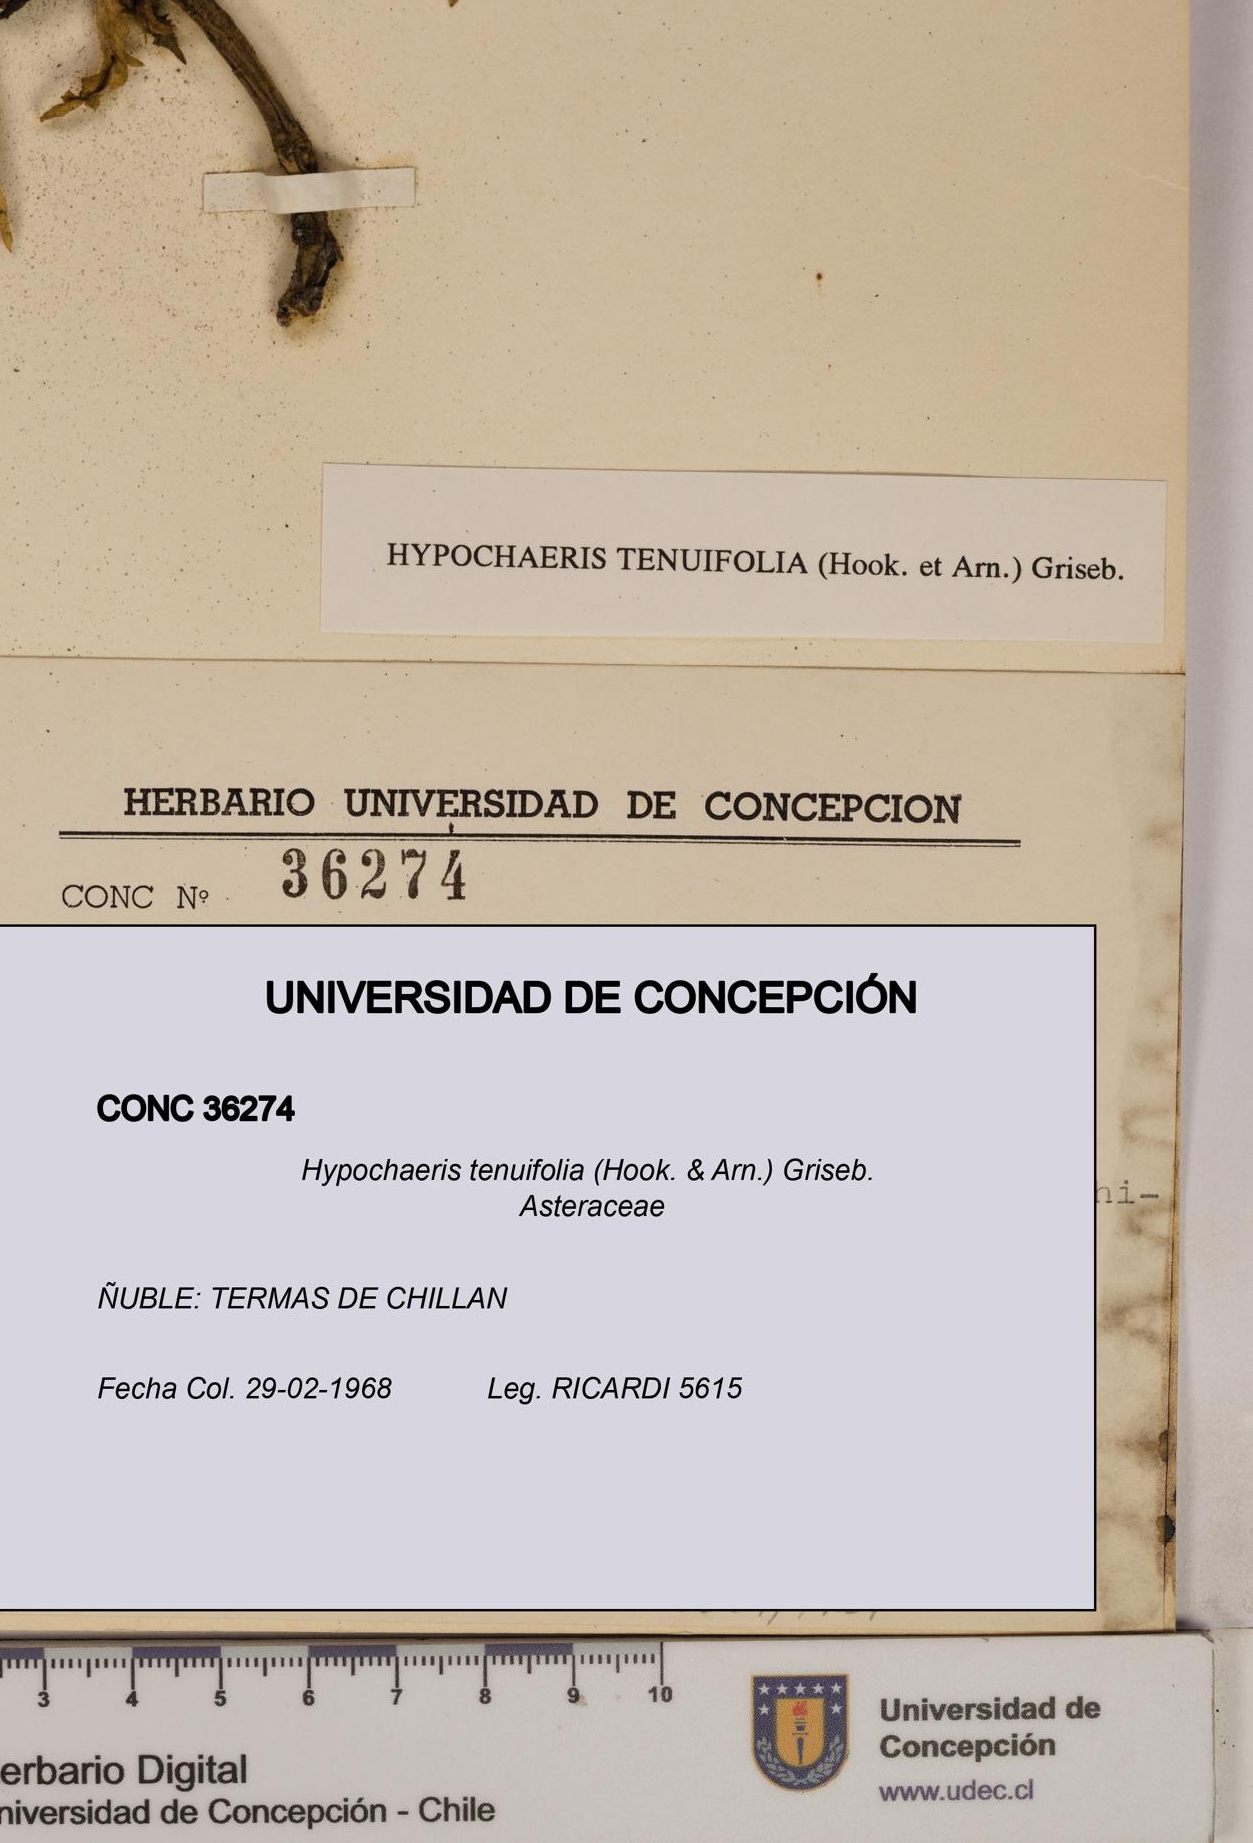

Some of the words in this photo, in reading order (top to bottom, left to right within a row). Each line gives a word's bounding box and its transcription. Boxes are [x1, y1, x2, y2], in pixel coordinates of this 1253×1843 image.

[386, 542, 608, 570] HYPOCHAERIS
[616, 547, 809, 575] TENUIFOLIA
[818, 551, 908, 581] (Hook.
[919, 556, 943, 577] et
[951, 555, 1022, 585] Arn.)
[1031, 555, 1124, 581] Griseb.
[123, 786, 316, 817] HERBARIO
[344, 787, 599, 819] UNIVERSIDAD
[626, 789, 677, 820] DE
[704, 790, 963, 825] CONCEPCION
[61, 884, 155, 910] CONC
[281, 847, 467, 901] 36274
[37, 1693, 51, 1709] 3
[124, 1693, 140, 1708] 4
[213, 1692, 228, 1708] 5
[302, 1692, 316, 1707] 6
[390, 1691, 404, 1706] 7
[478, 1691, 492, 1705] 8
[567, 1691, 581, 1705] 9
[648, 1688, 673, 1703] 10
[880, 1695, 1056, 1723] Universidad
[1064, 1695, 1102, 1720] de
[879, 1732, 1056, 1763] Concepción
[137, 1753, 247, 1791] Digital
[878, 1778, 1034, 1802] www.udec.cl
[159, 1798, 199, 1825] de
[207, 1796, 387, 1829] Concepción
[418, 1795, 496, 1823] Chile
